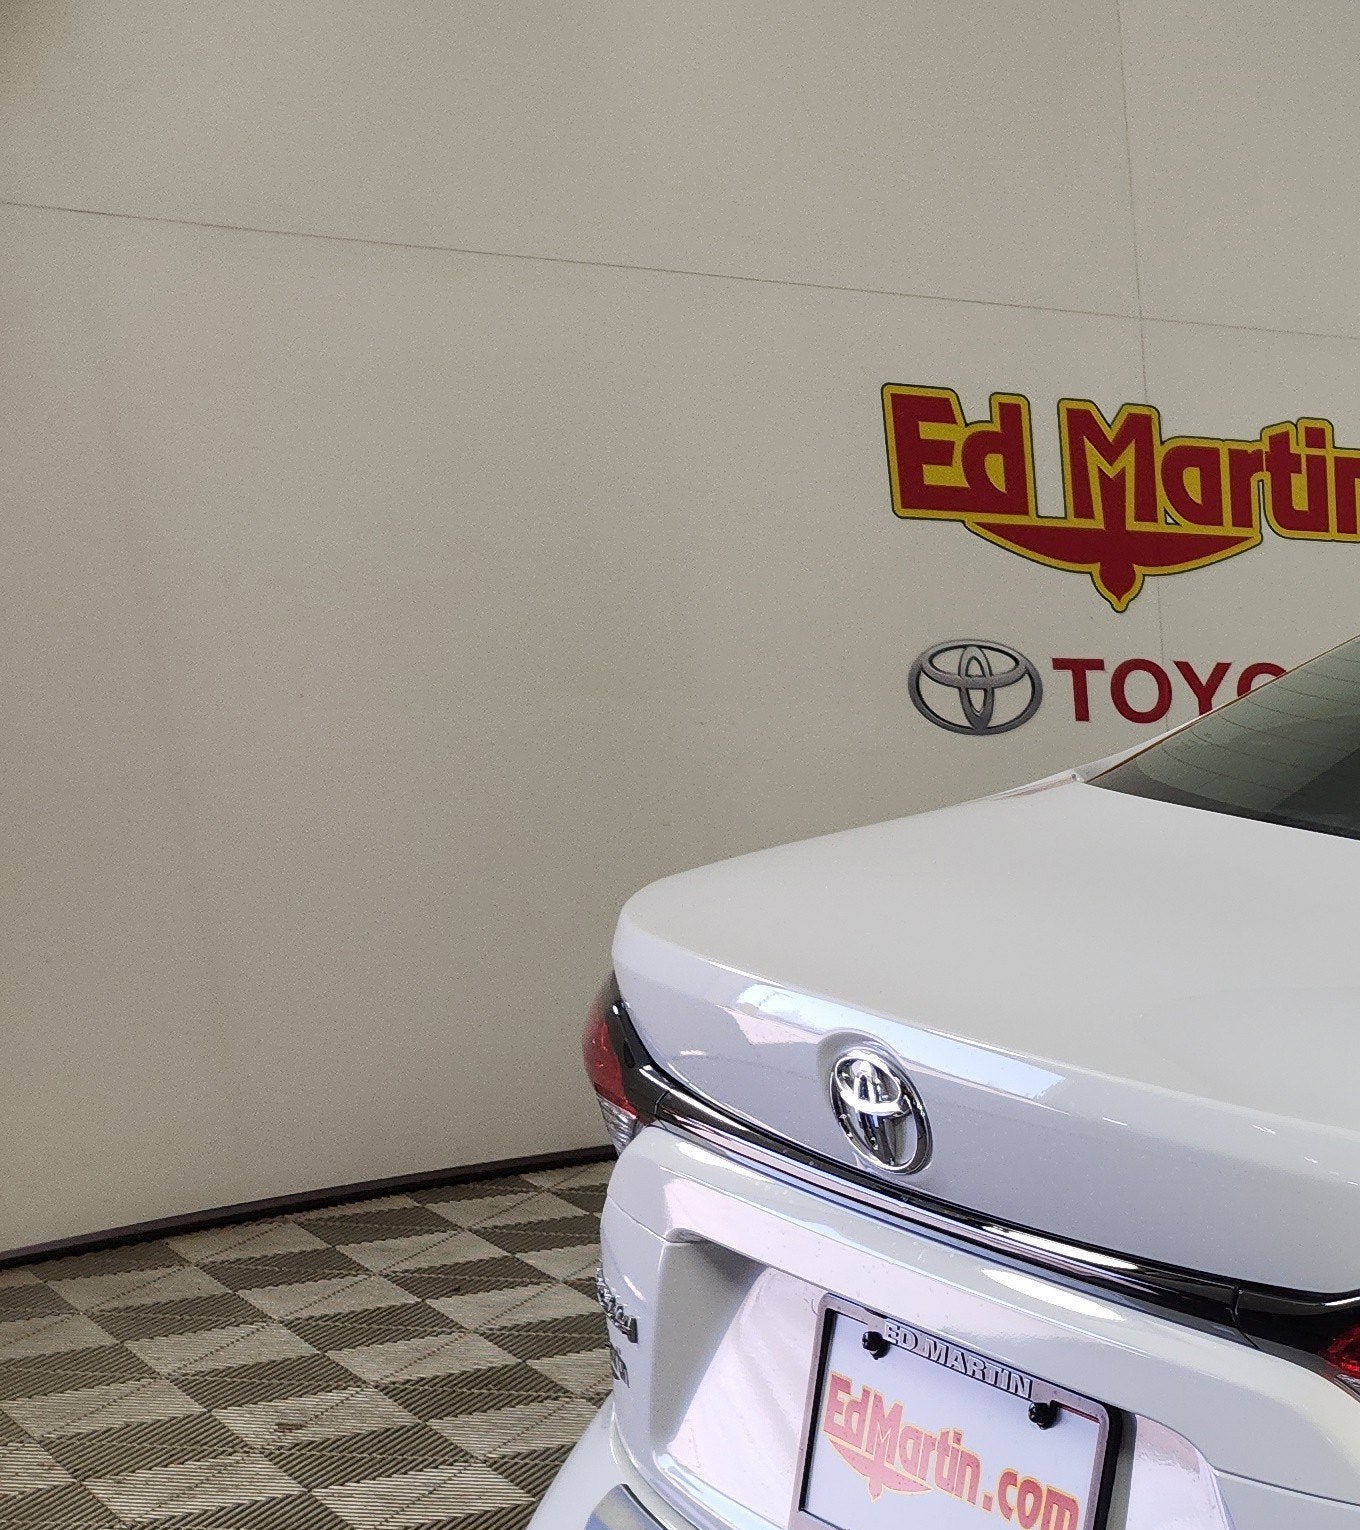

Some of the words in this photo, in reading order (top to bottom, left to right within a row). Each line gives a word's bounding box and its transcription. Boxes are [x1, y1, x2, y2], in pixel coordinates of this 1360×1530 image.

[884, 386, 1036, 520] Ed
[883, 1320, 919, 1350] ED
[924, 1338, 1034, 1399] MARTIN
